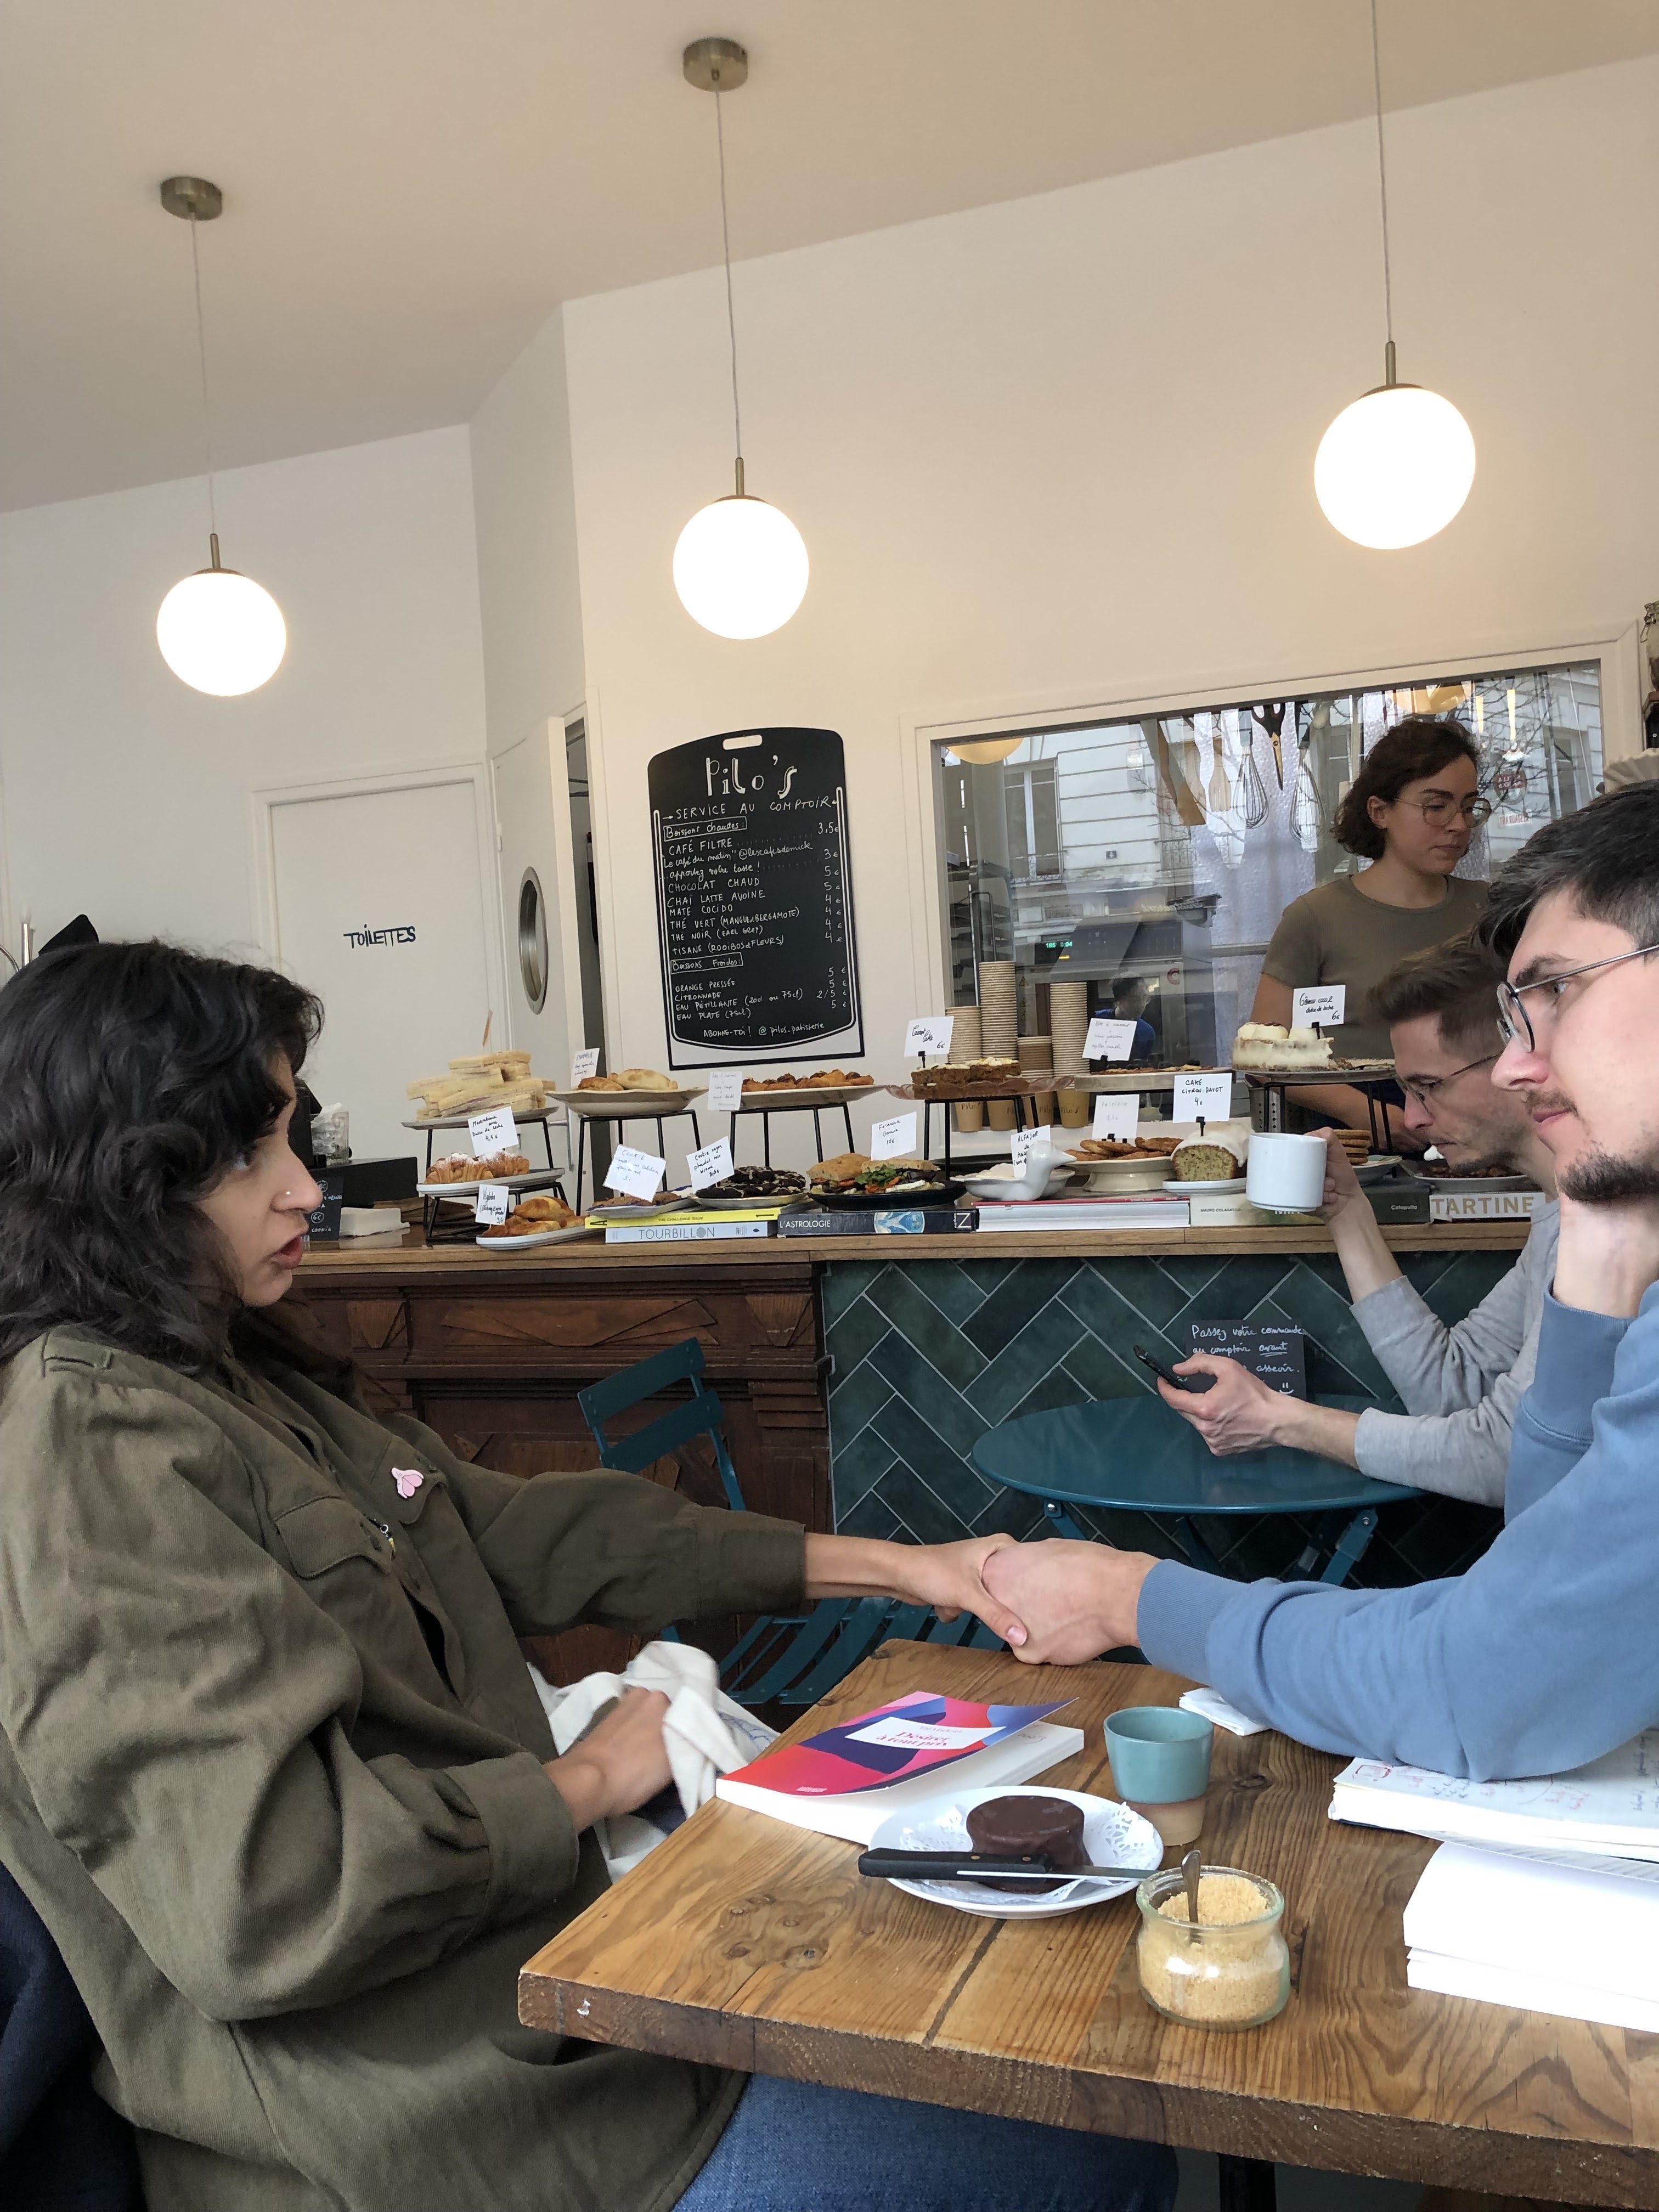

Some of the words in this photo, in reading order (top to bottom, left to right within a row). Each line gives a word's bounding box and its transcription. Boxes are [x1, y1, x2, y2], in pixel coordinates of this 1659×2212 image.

[706, 755, 797, 799] Pilo's
[676, 803, 726, 819] SERVICE
[740, 803, 754, 814] AU
[666, 826, 699, 838] Boissons
[669, 839, 693, 855] CAFÉ
[700, 838, 732, 851] FILTRE
[675, 856, 691, 868] café
[709, 865, 728, 875] votre
[733, 864, 753, 873] tasse
[668, 880, 715, 893] CHOCOLAT
[727, 878, 760, 888] CHAUD
[701, 894, 723, 903] LATTE
[731, 890, 766, 901] AVOINE
[669, 907, 691, 917] MATE
[670, 918, 686, 929] THÉ
[695, 918, 715, 928] VERT
[671, 932, 684, 941] THÉ
[691, 929, 712, 939] NOIR
[673, 945, 702, 955] TISANE
[673, 960, 702, 971] Boissons
[675, 983, 703, 992] ORANGE
[674, 992, 721, 1002] CITRONNADE
[698, 1011, 720, 1020] PLATE
[1431, 1196, 1534, 1215] TARTINE
[780, 1220, 831, 1228] L'ASTROLOGIE
[639, 1227, 715, 1239] TOURBILLON
[1192, 1324, 1227, 1341] Passez
[1233, 1325, 1257, 1336] votre
[1261, 1325, 1304, 1335] commande
[1210, 1342, 1250, 1356] comptoir
[1259, 1341, 1288, 1352] avant
